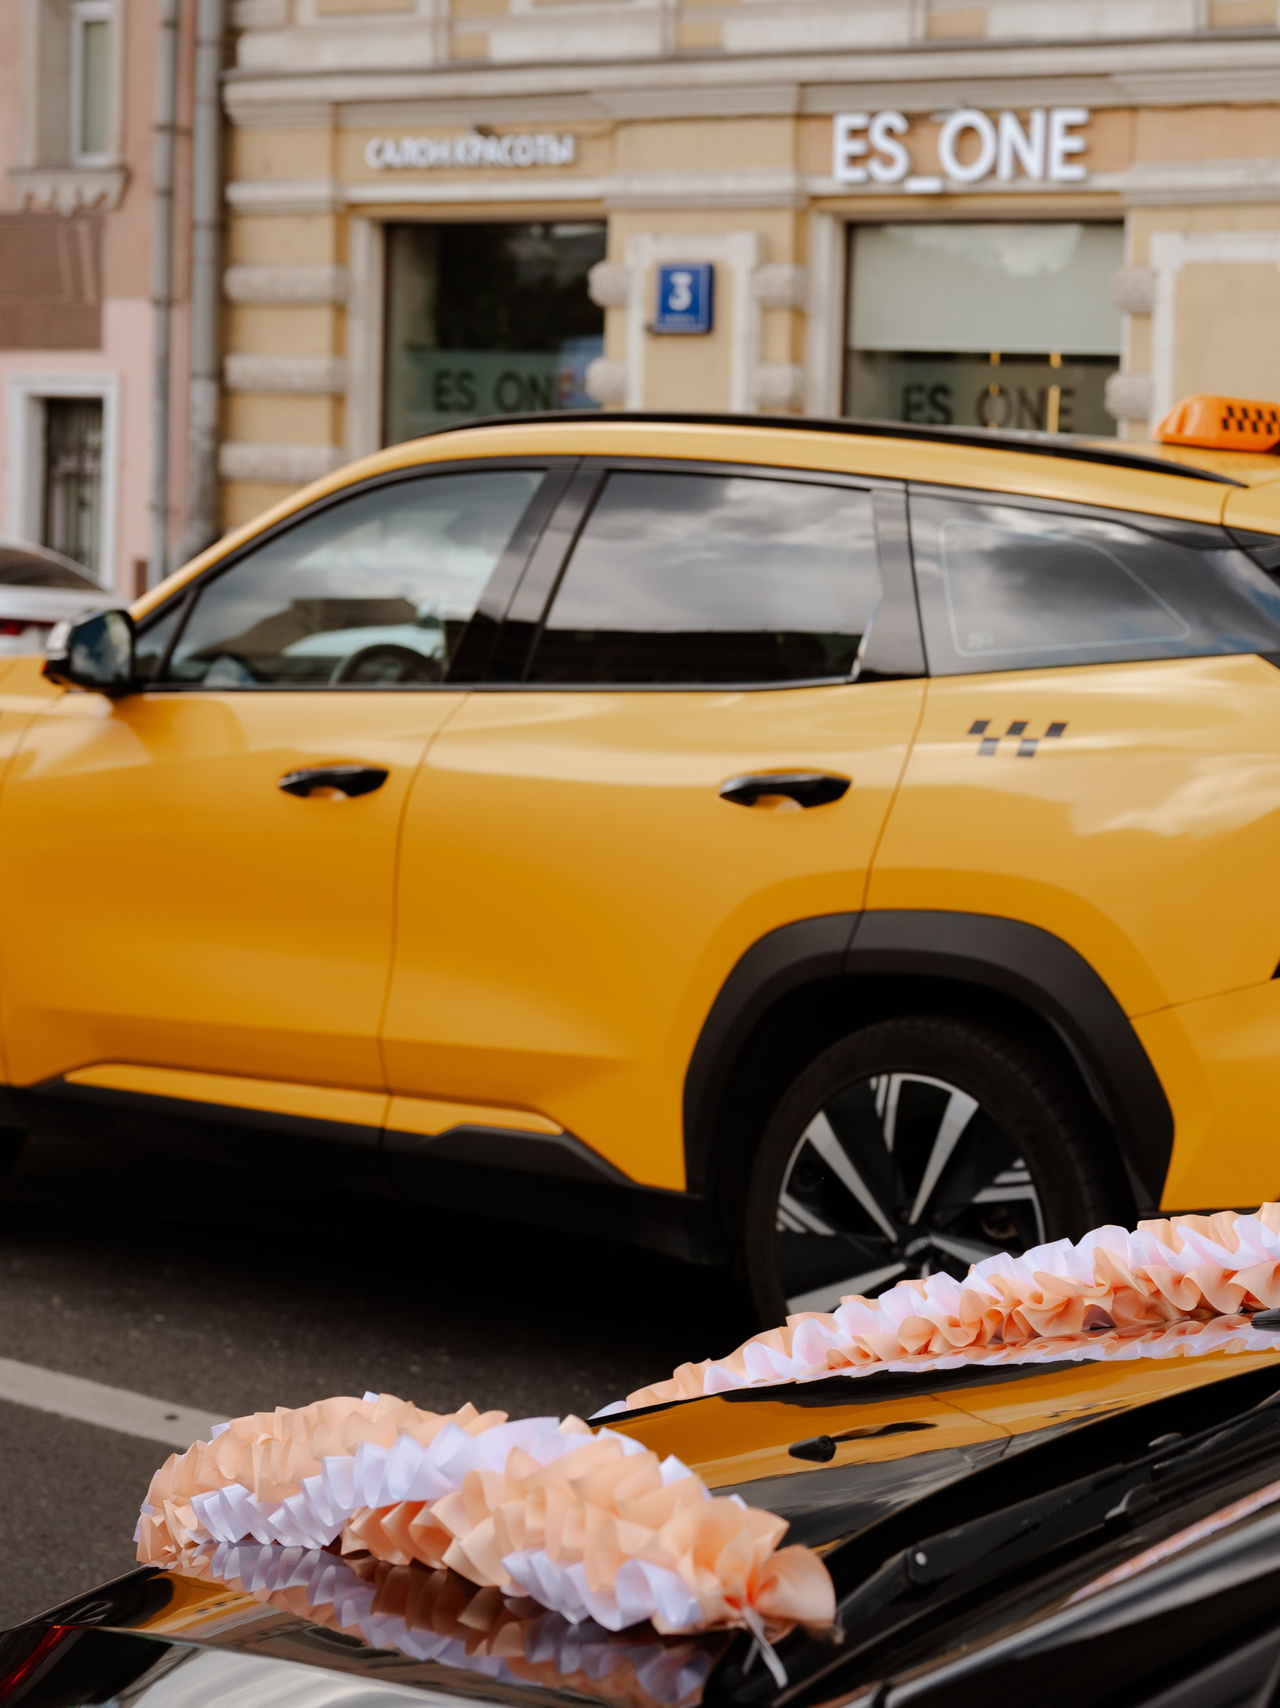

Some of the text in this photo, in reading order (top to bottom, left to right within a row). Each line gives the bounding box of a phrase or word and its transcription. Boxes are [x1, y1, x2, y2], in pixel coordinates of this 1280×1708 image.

[365, 133, 576, 169] САЛОН КРАСОТЫ
[668, 271, 693, 312] 3
